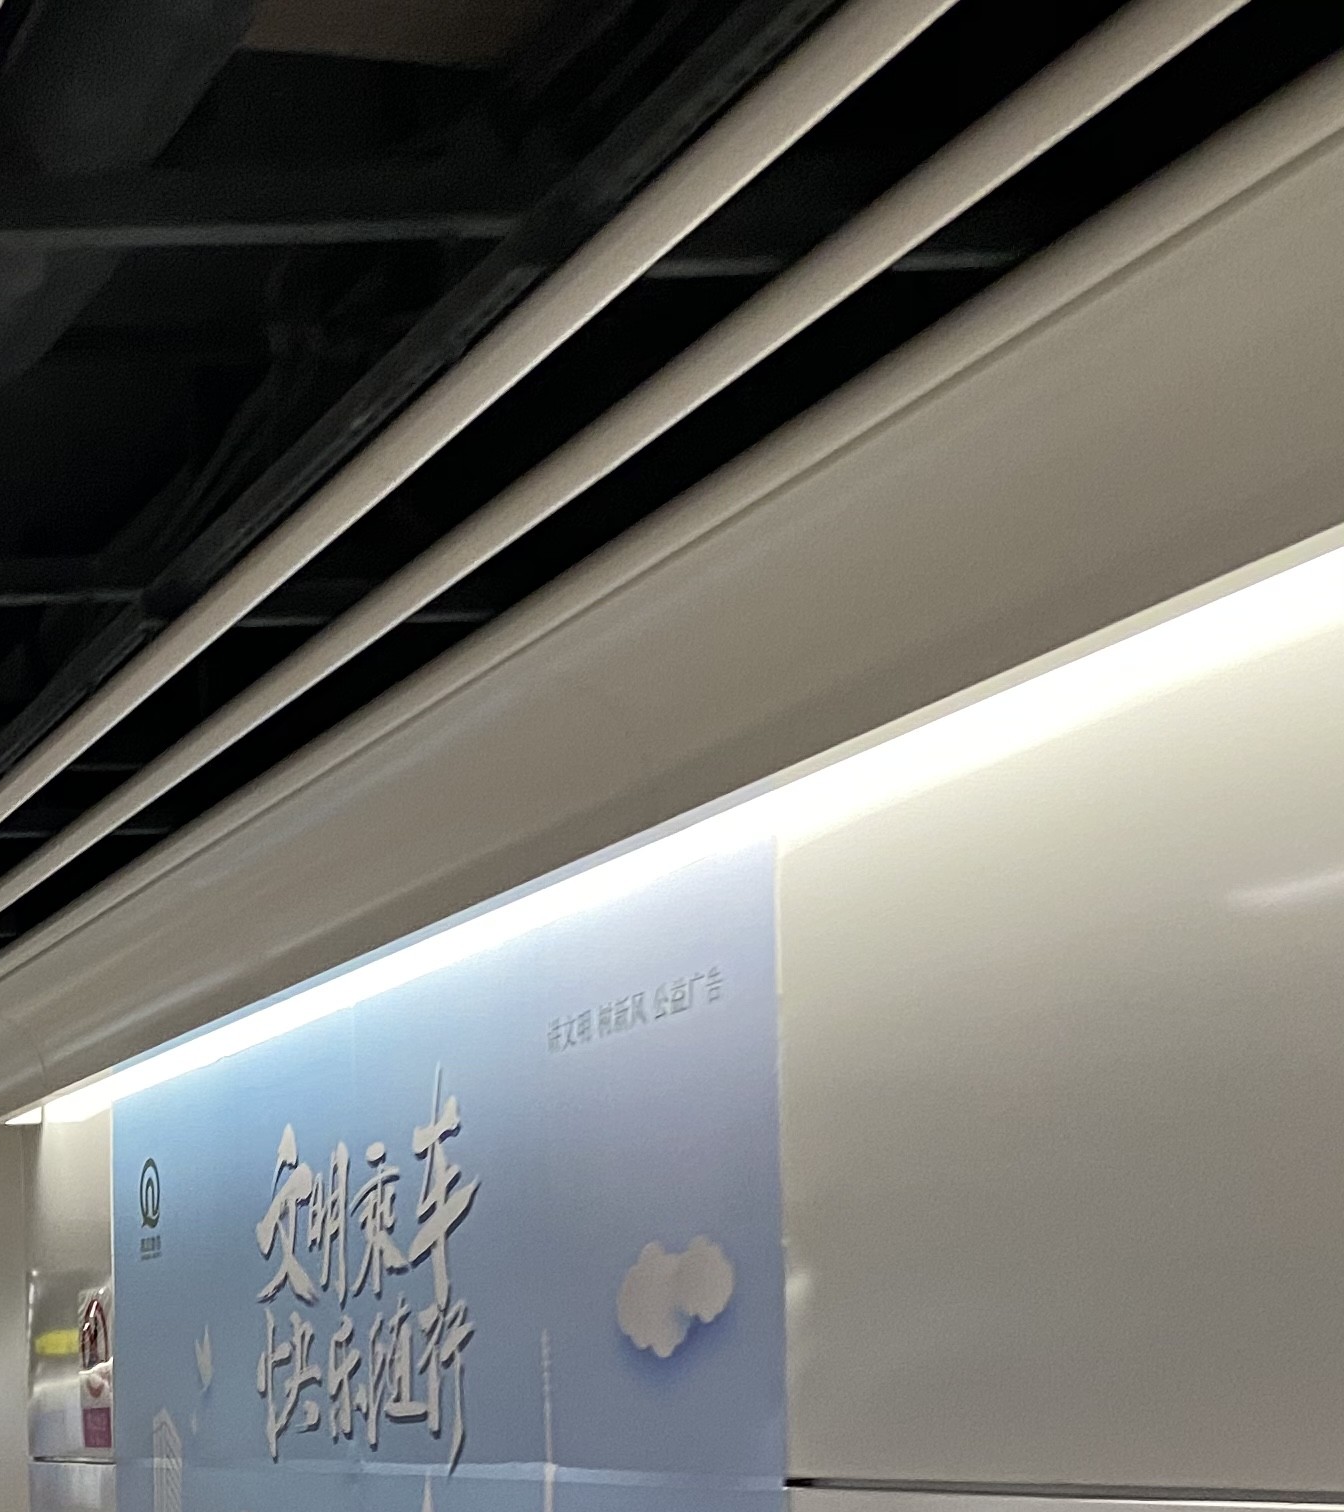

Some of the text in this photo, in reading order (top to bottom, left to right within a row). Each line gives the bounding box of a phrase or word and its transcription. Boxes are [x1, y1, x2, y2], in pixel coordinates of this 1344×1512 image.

[255, 1060, 481, 1310] 文明乘车
[256, 1292, 475, 1476] 快乐随行
